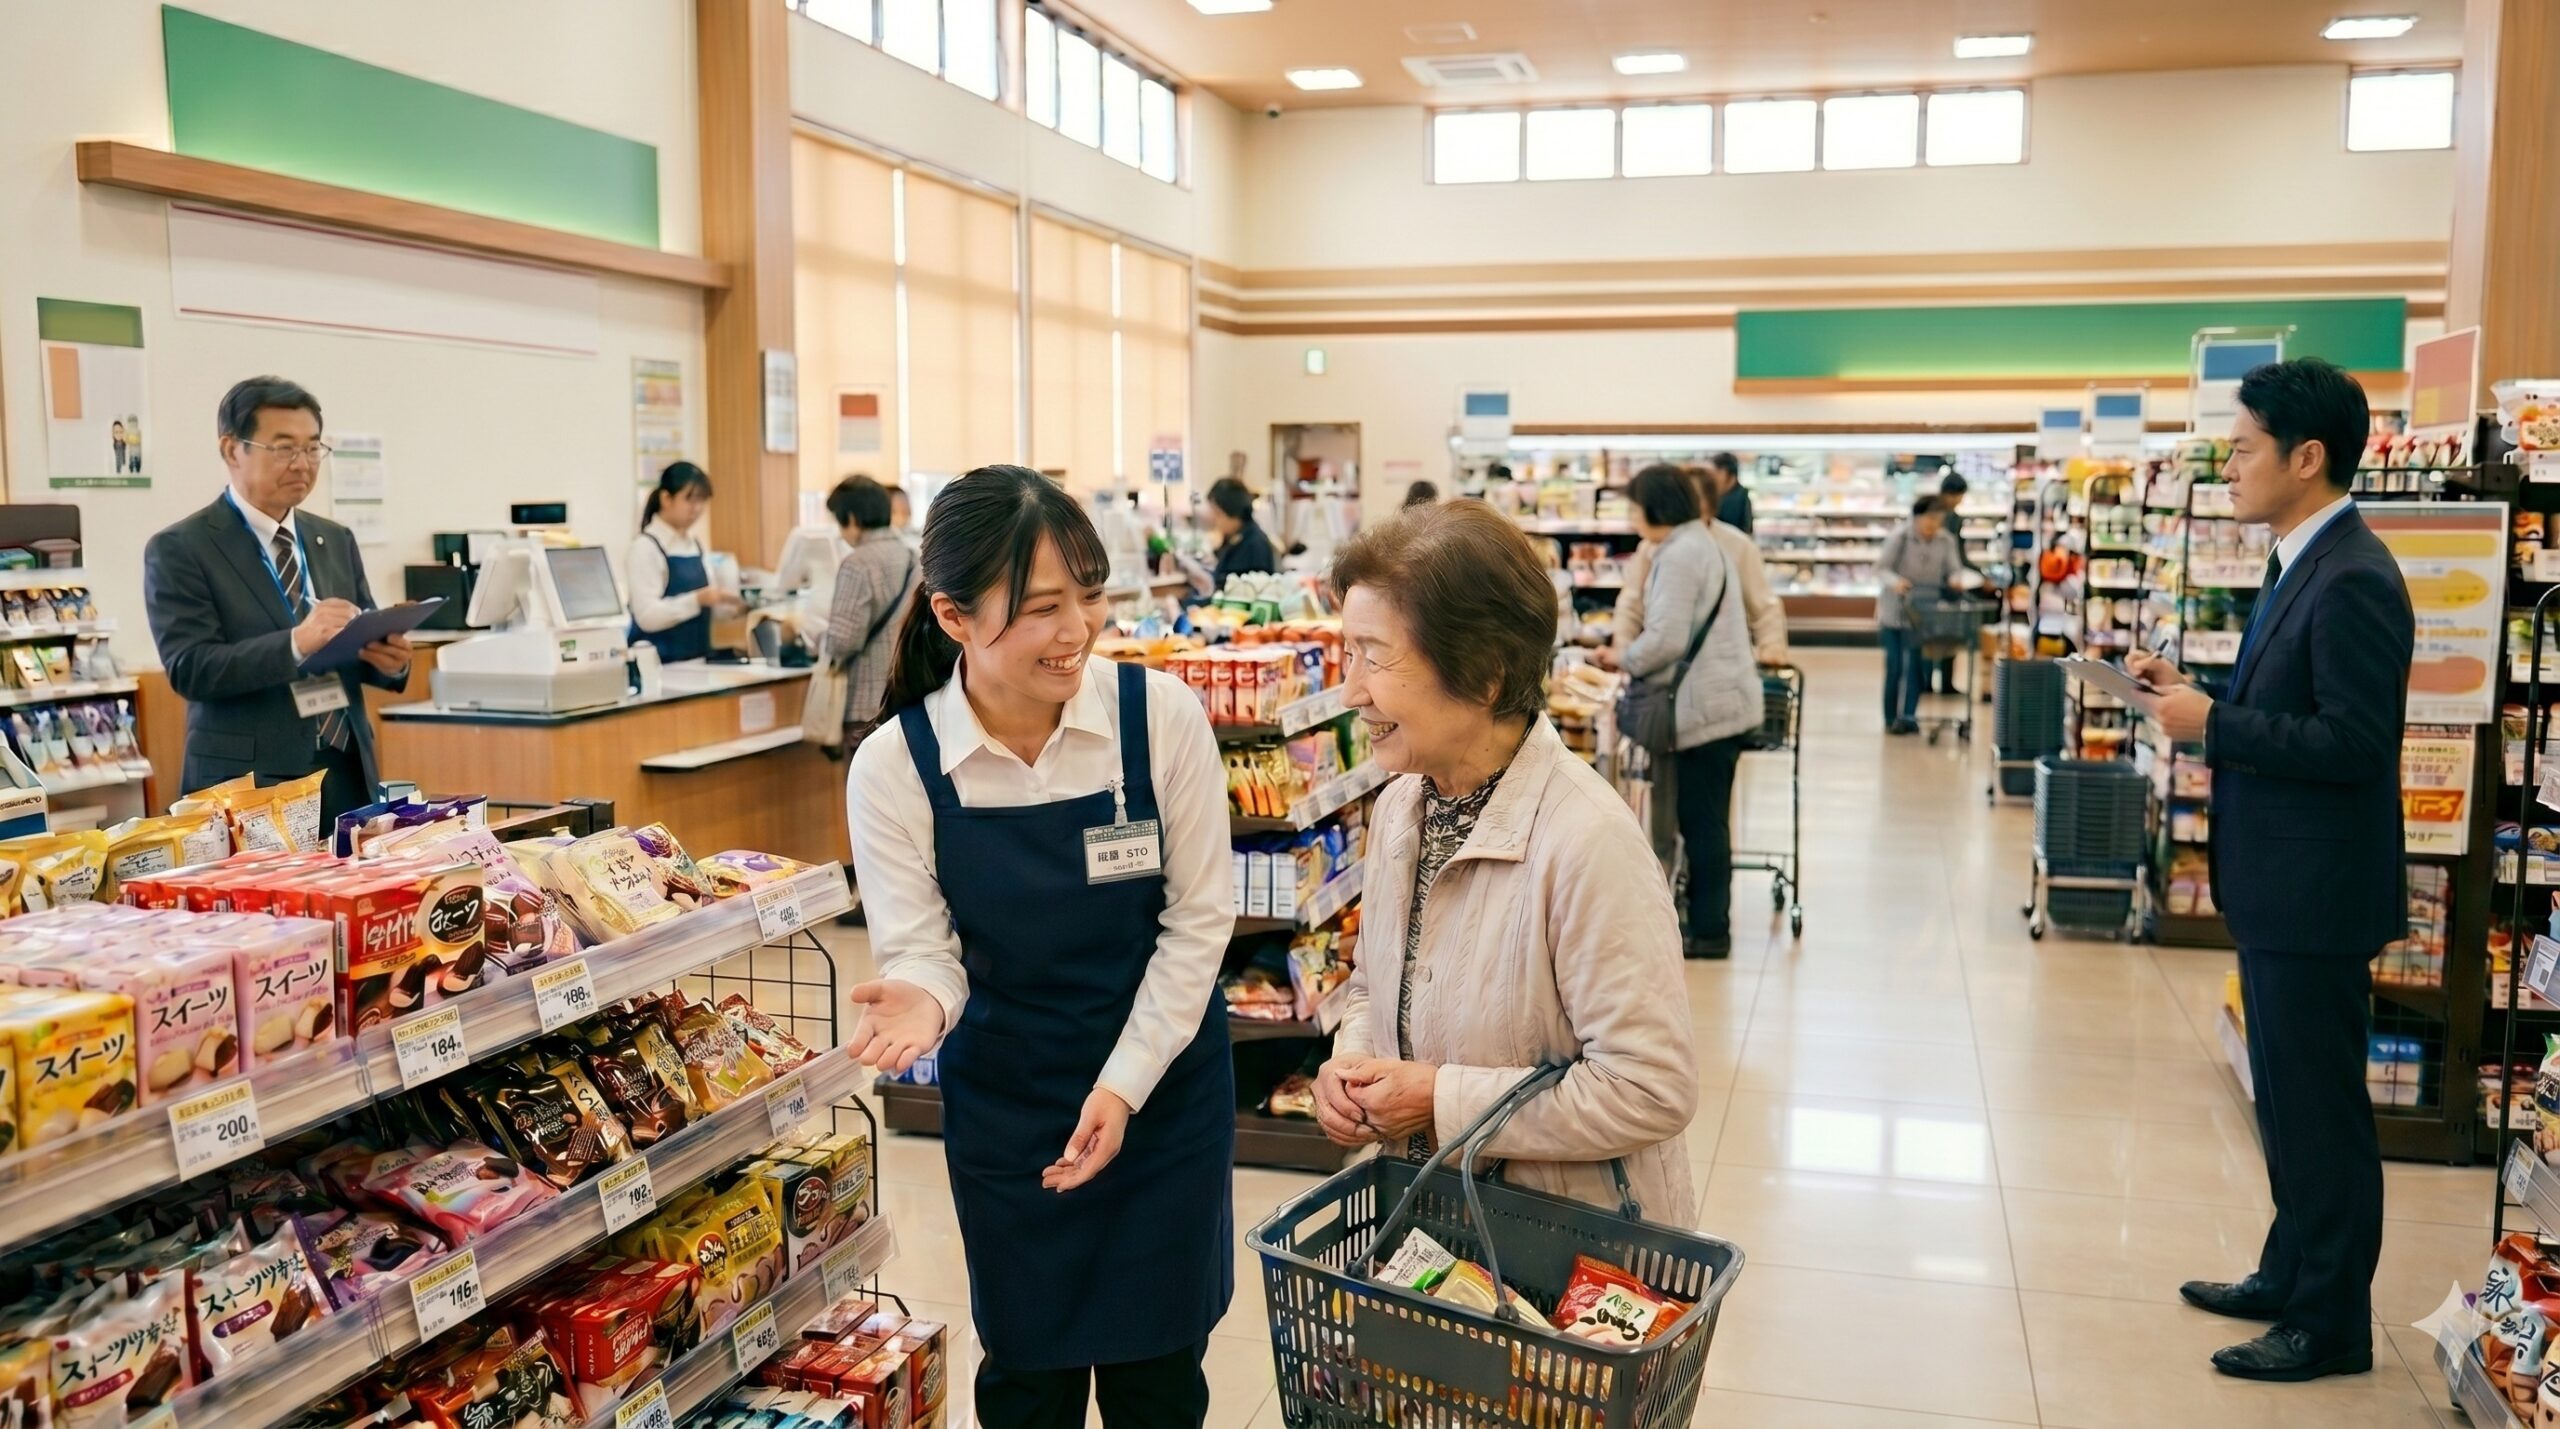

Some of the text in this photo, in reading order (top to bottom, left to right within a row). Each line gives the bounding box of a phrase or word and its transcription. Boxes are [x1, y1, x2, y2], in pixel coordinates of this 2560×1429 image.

[254, 958, 327, 1003] スイーツ
[151, 986, 227, 1034] スイーツ
[36, 1033, 125, 1085] スイーツ
